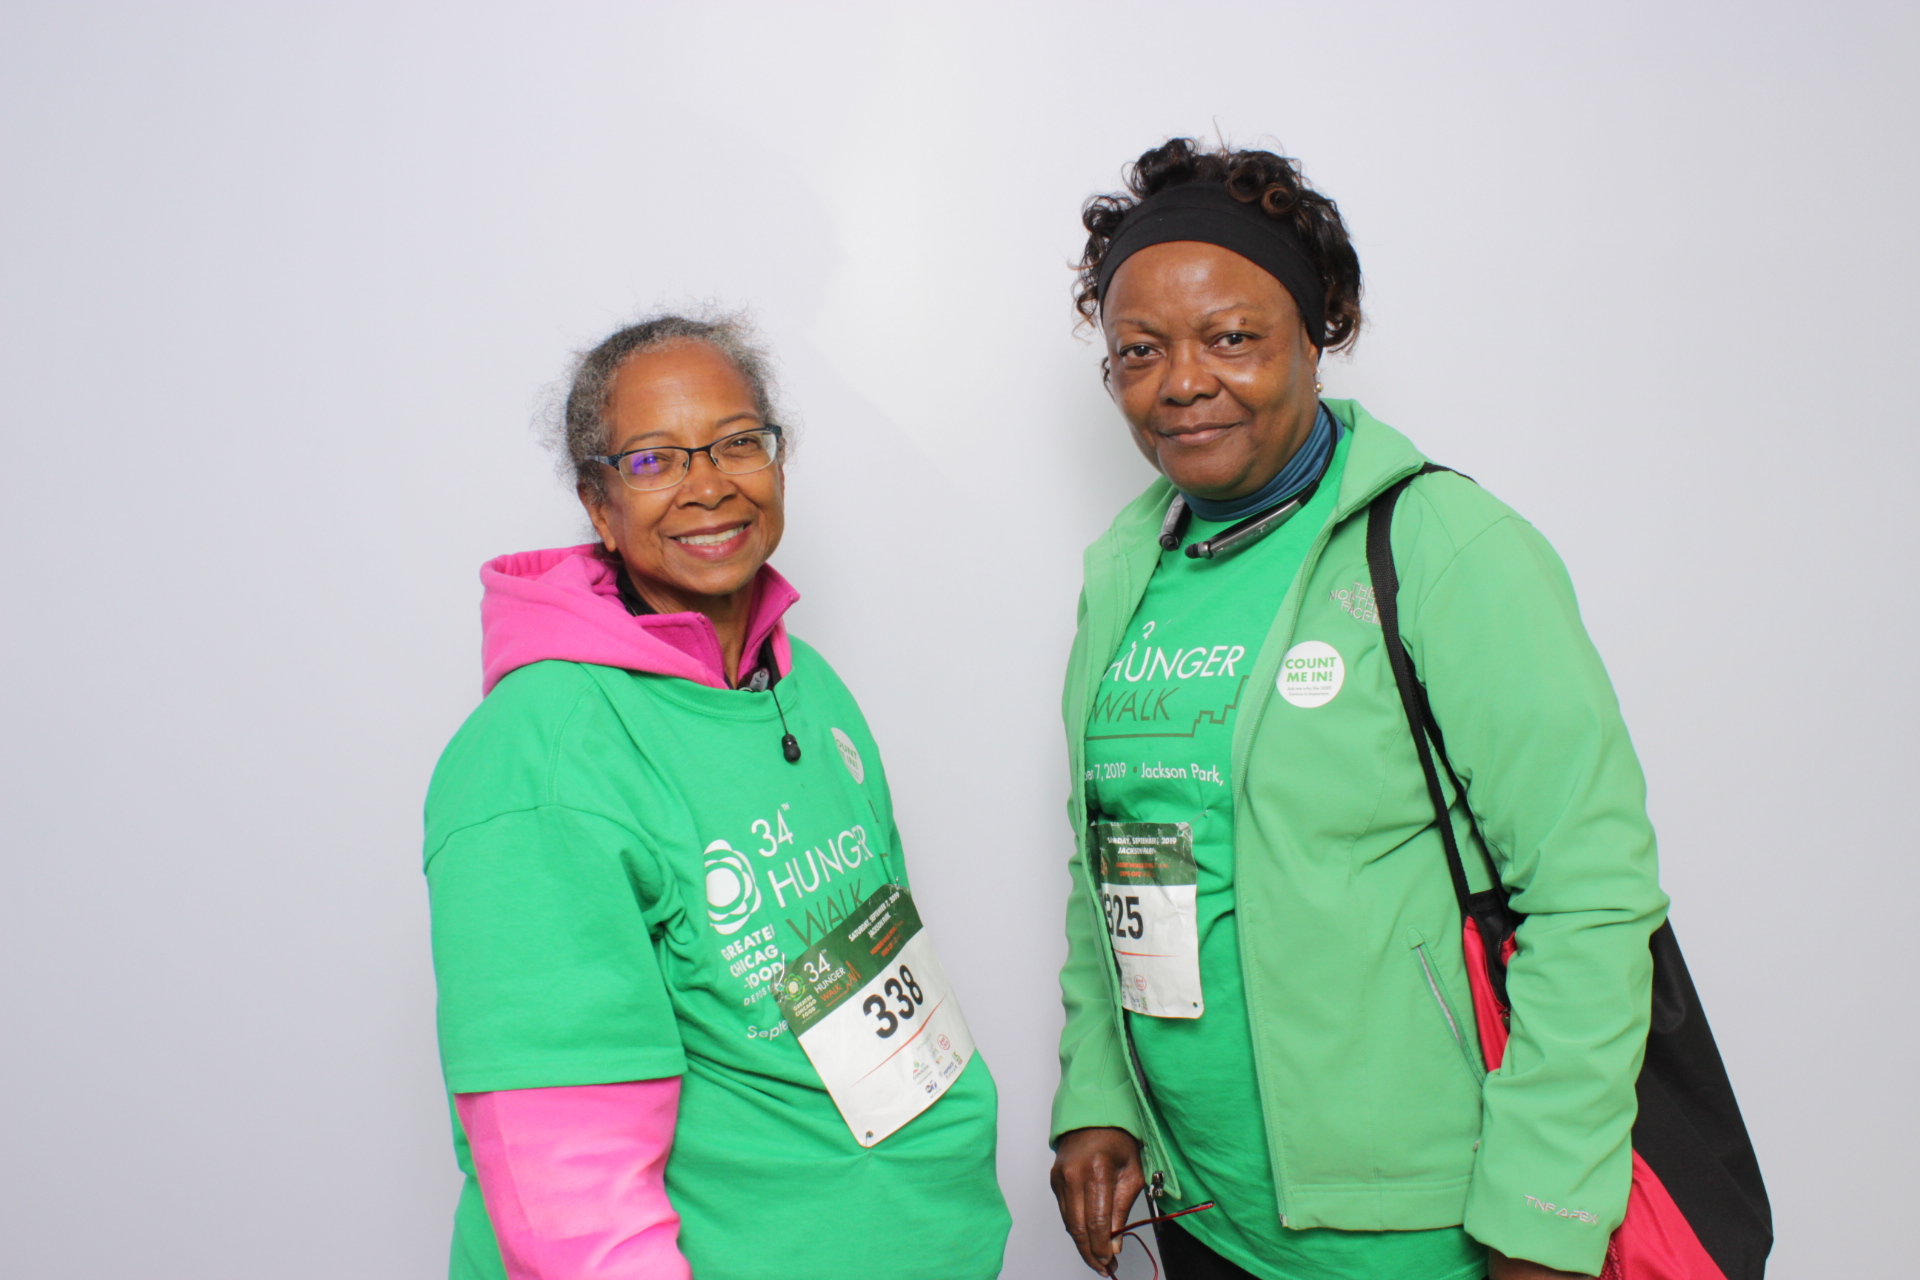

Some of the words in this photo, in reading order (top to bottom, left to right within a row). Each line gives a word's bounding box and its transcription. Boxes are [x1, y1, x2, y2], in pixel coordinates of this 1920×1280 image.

[1102, 645, 1245, 683] HUNGER
[1285, 657, 1336, 669] COUNT
[1286, 672, 1308, 682] ME
[1312, 671, 1333, 682] IN!
[1092, 687, 1180, 724] WALK
[1141, 761, 1188, 779] Jackson
[1191, 763, 1225, 787] Park,
[1103, 893, 1144, 940] 325
[730, 944, 779, 977] CHICAG
[814, 967, 846, 994] HUNGER
[820, 983, 843, 1001] WALK
[795, 999, 817, 1017] CHICAGO
[802, 1006, 816, 1019] FOOD
[863, 964, 924, 1039] 338
[1523, 1194, 1556, 1212] TNF
